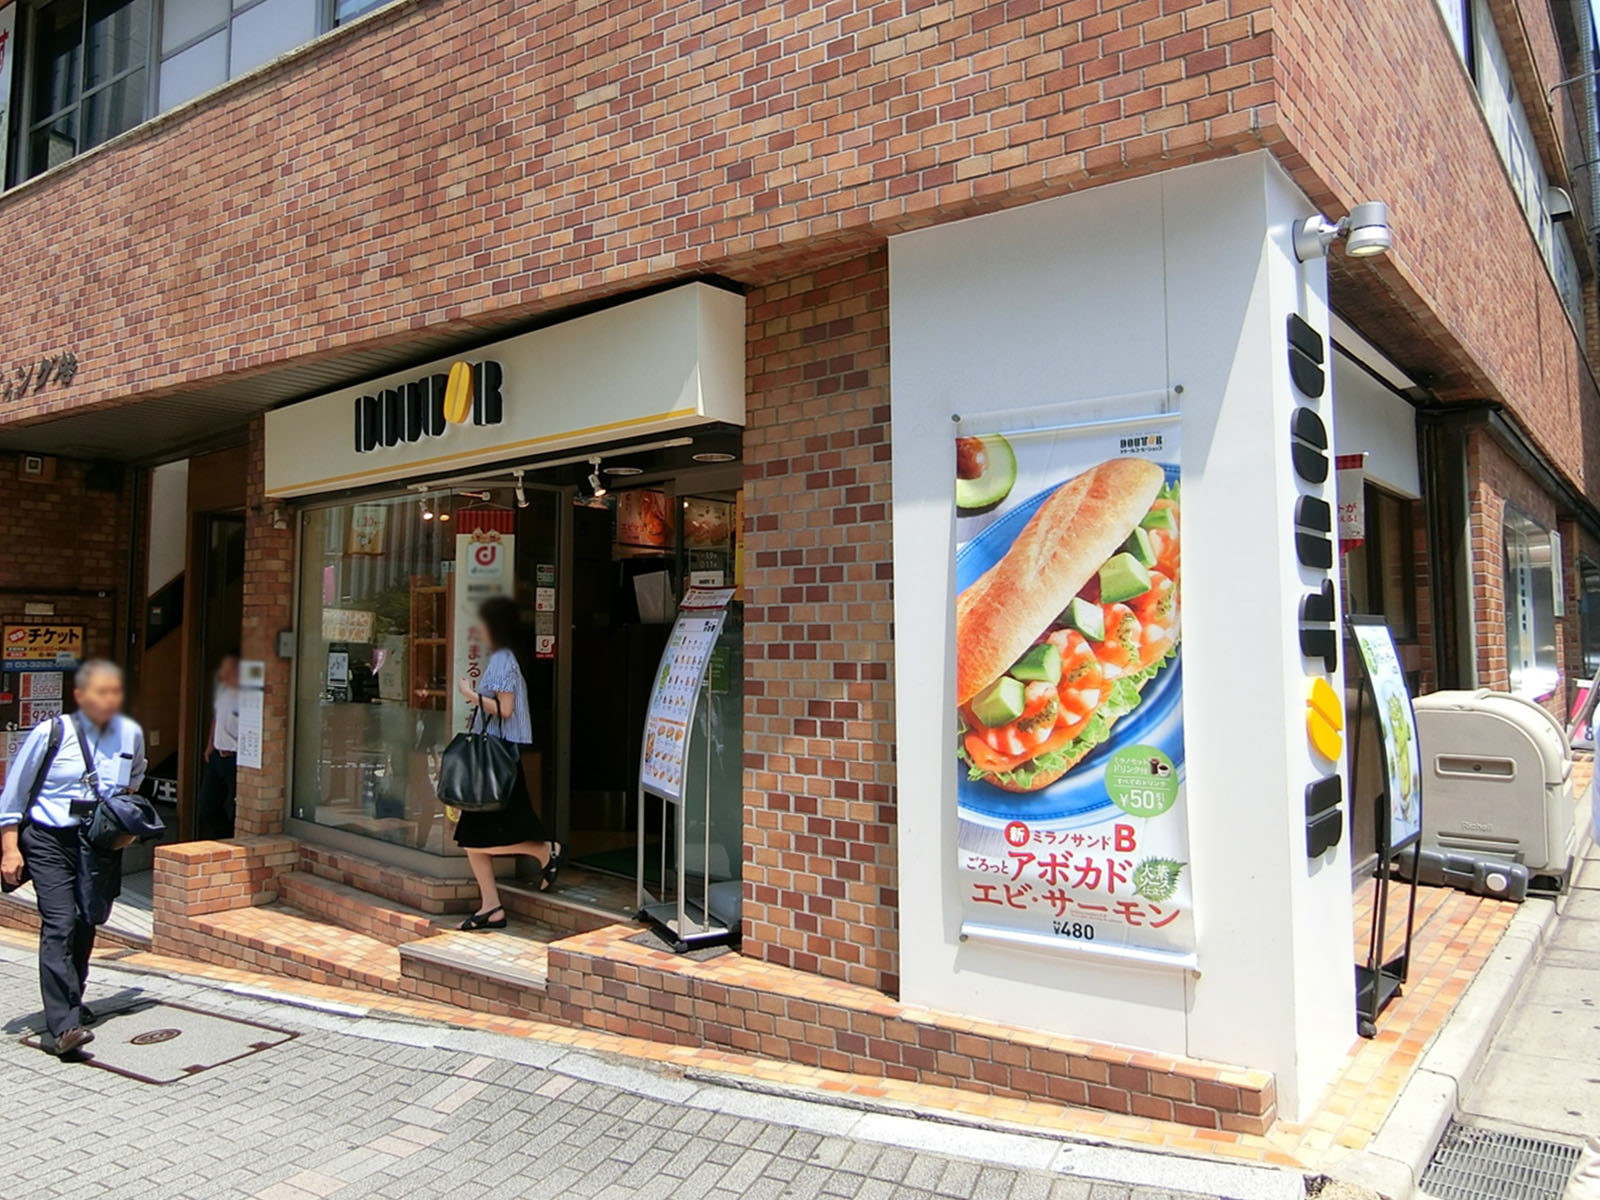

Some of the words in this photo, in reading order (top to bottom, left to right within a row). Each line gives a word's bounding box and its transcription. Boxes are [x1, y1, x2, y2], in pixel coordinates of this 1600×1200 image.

[355, 361, 503, 453] DOUTOR
[1120, 435, 1163, 449] DOUTOR
[1287, 312, 1343, 859] DOUTOR
[28, 628, 79, 645] チケット
[1009, 825, 1027, 843] 新
[1032, 829, 1111, 851] ミラノサンド
[1114, 823, 1137, 852] B
[966, 856, 1009, 875] ごろっと
[1007, 849, 1134, 895] アボカド
[971, 882, 1181, 929] エビ・サーモン
